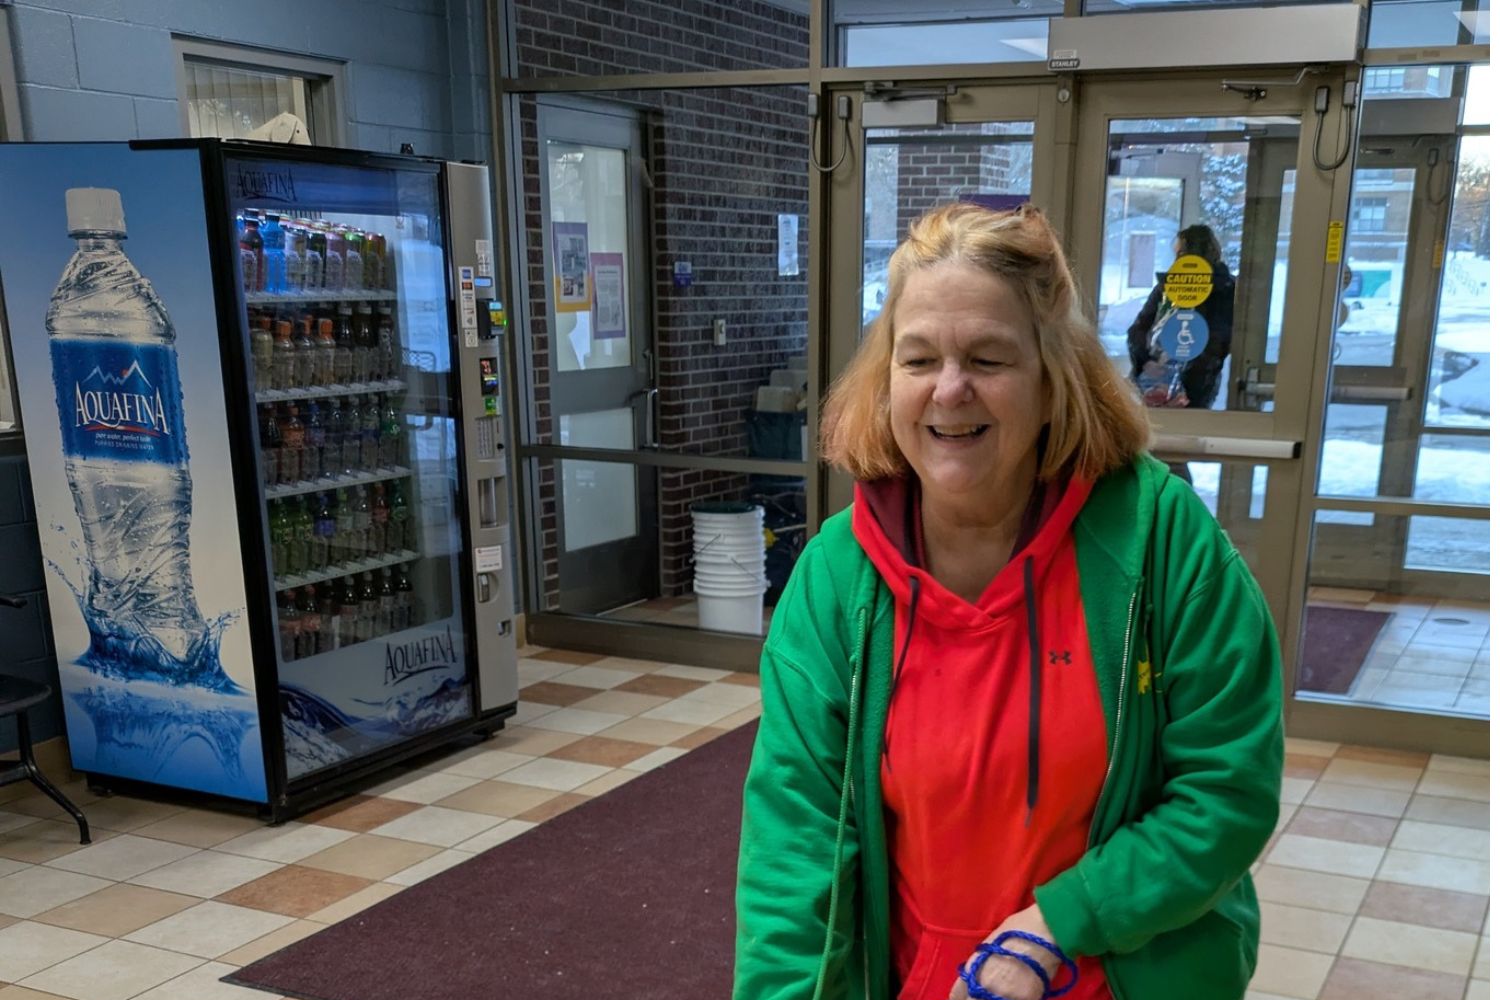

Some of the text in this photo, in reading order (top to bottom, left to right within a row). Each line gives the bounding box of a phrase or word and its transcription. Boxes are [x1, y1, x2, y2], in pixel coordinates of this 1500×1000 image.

[237, 164, 297, 201] AQUAFINA
[1166, 274, 1211, 284] CAUTION
[76, 381, 170, 434] AQUAFINA
[384, 624, 456, 685] AQUAFINA
